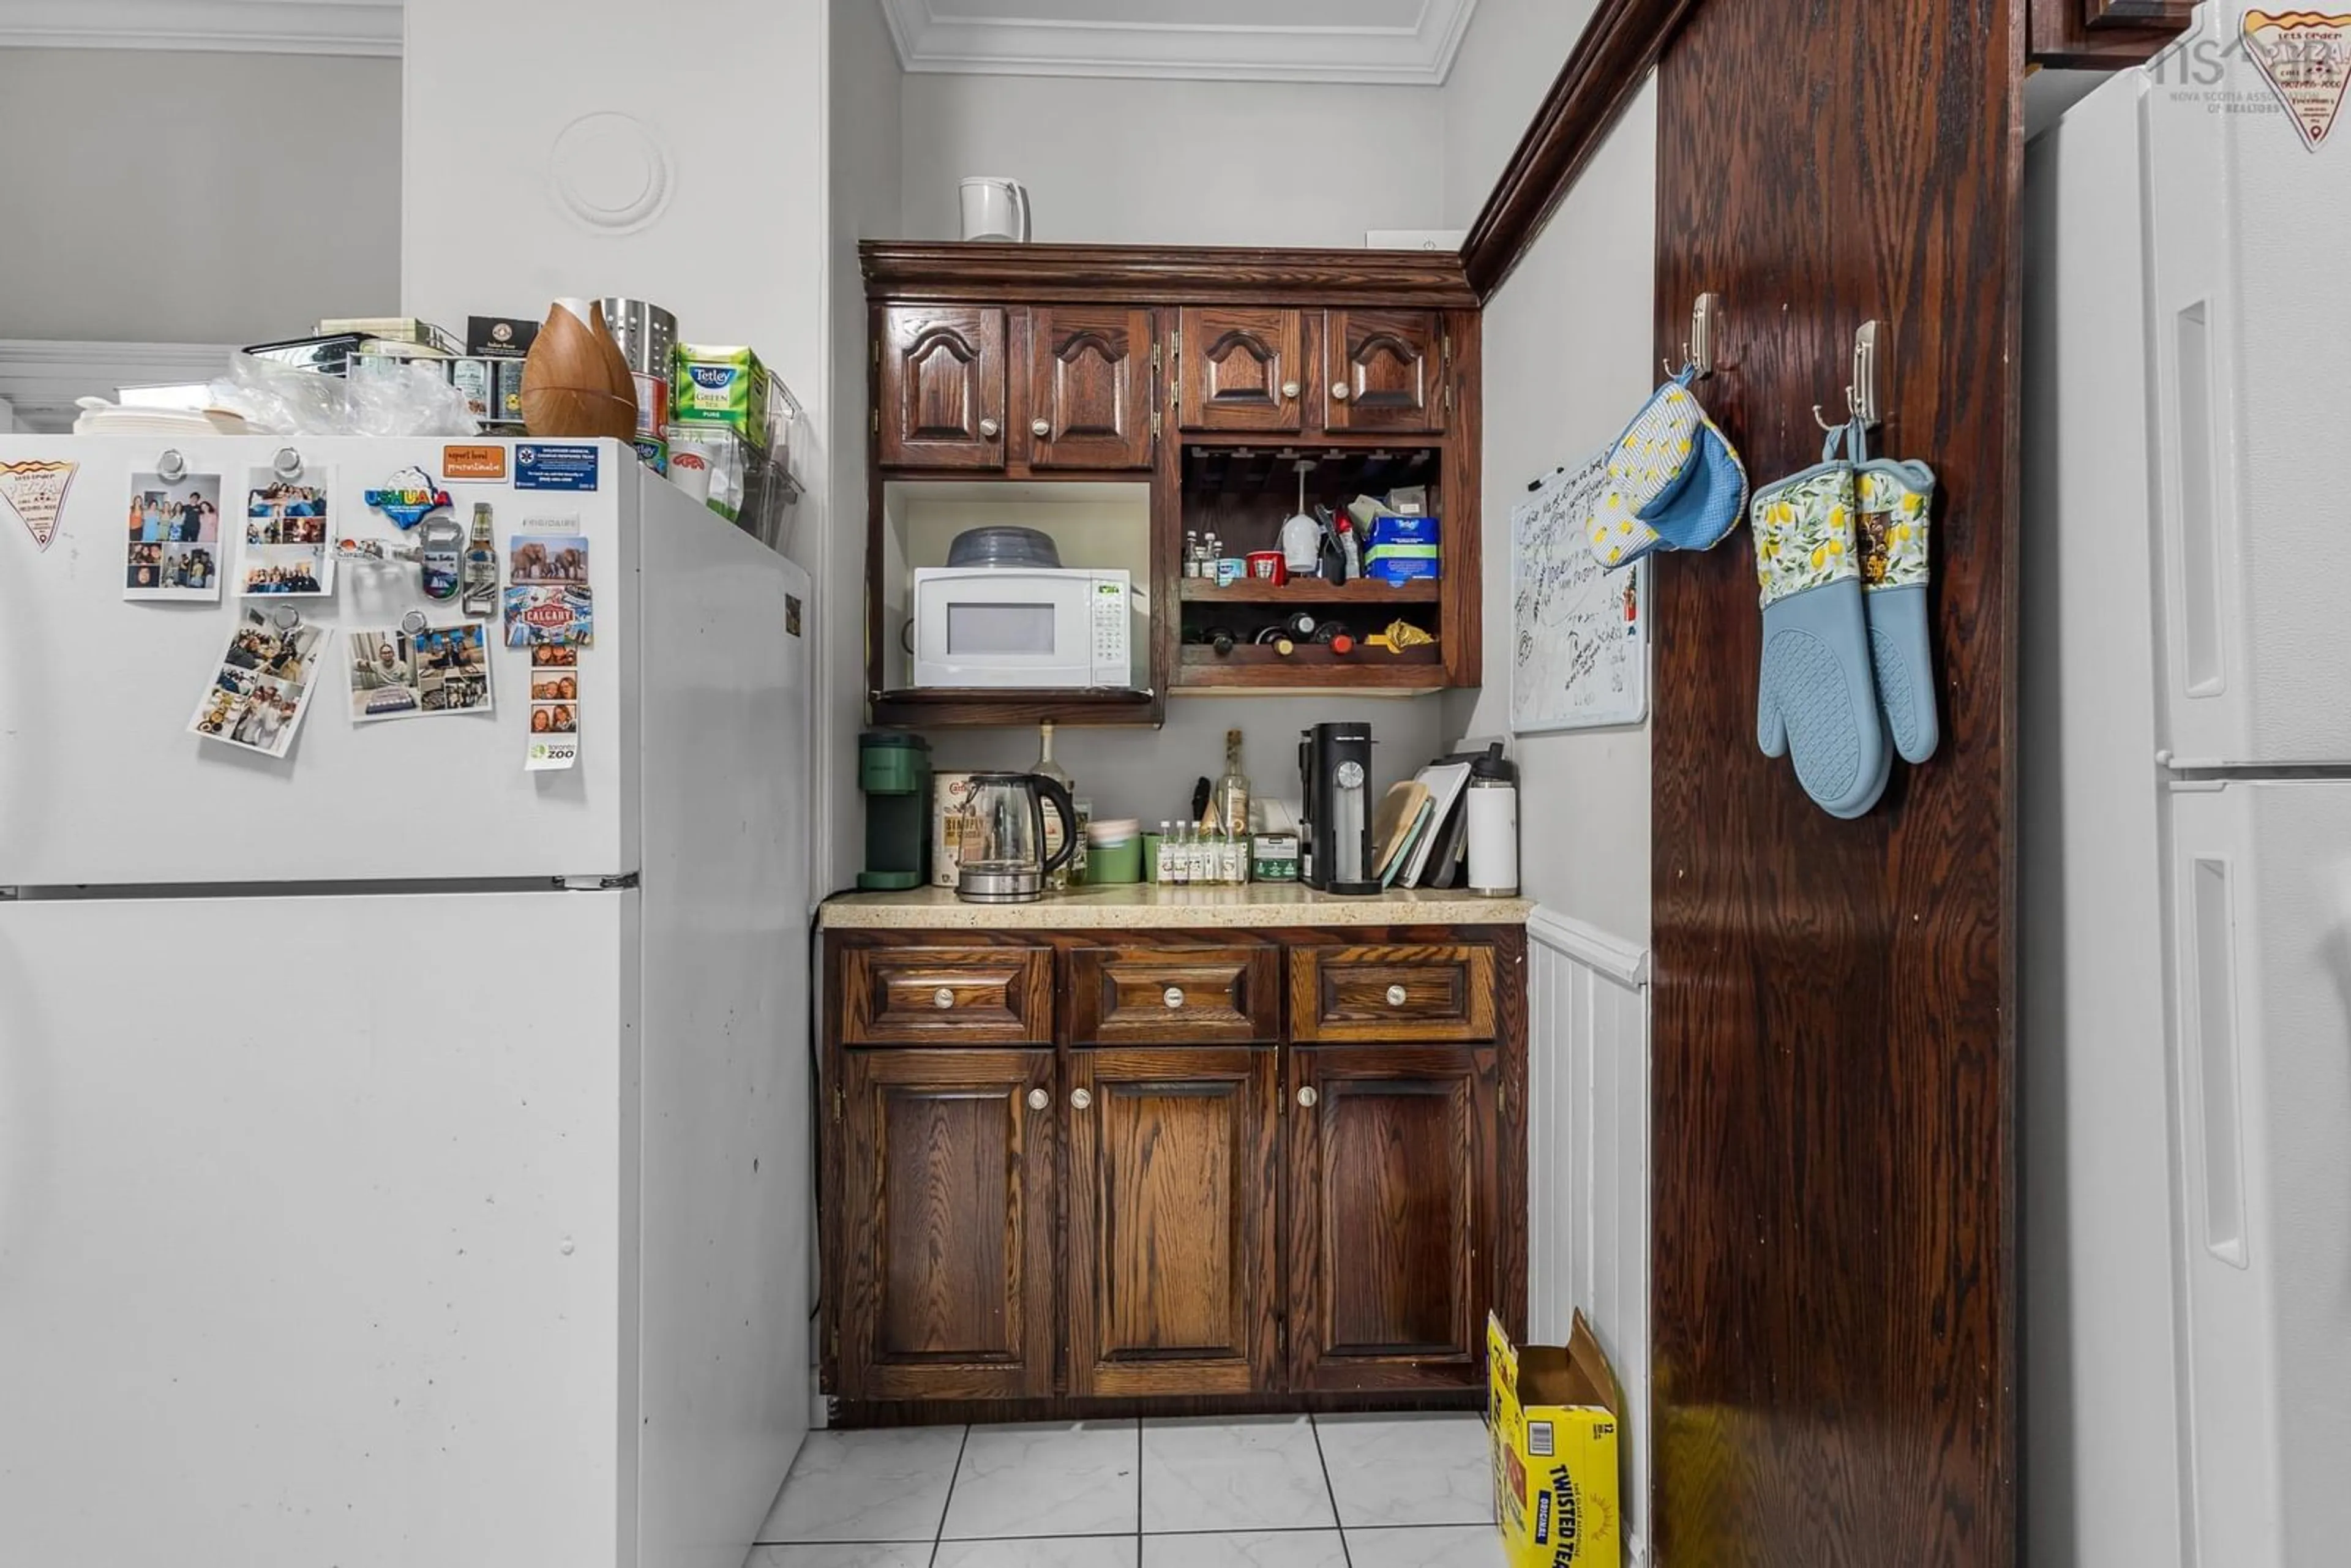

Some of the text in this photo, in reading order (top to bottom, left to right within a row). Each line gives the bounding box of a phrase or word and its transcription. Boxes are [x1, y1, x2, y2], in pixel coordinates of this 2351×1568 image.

[695, 369, 731, 384] Tetley
[527, 610, 571, 621] CALGARY
[1604, 1423, 1614, 1434] 12
[1549, 1464, 1576, 1539] TWISTED
[1537, 1498, 1549, 1538] ORIGINAL
